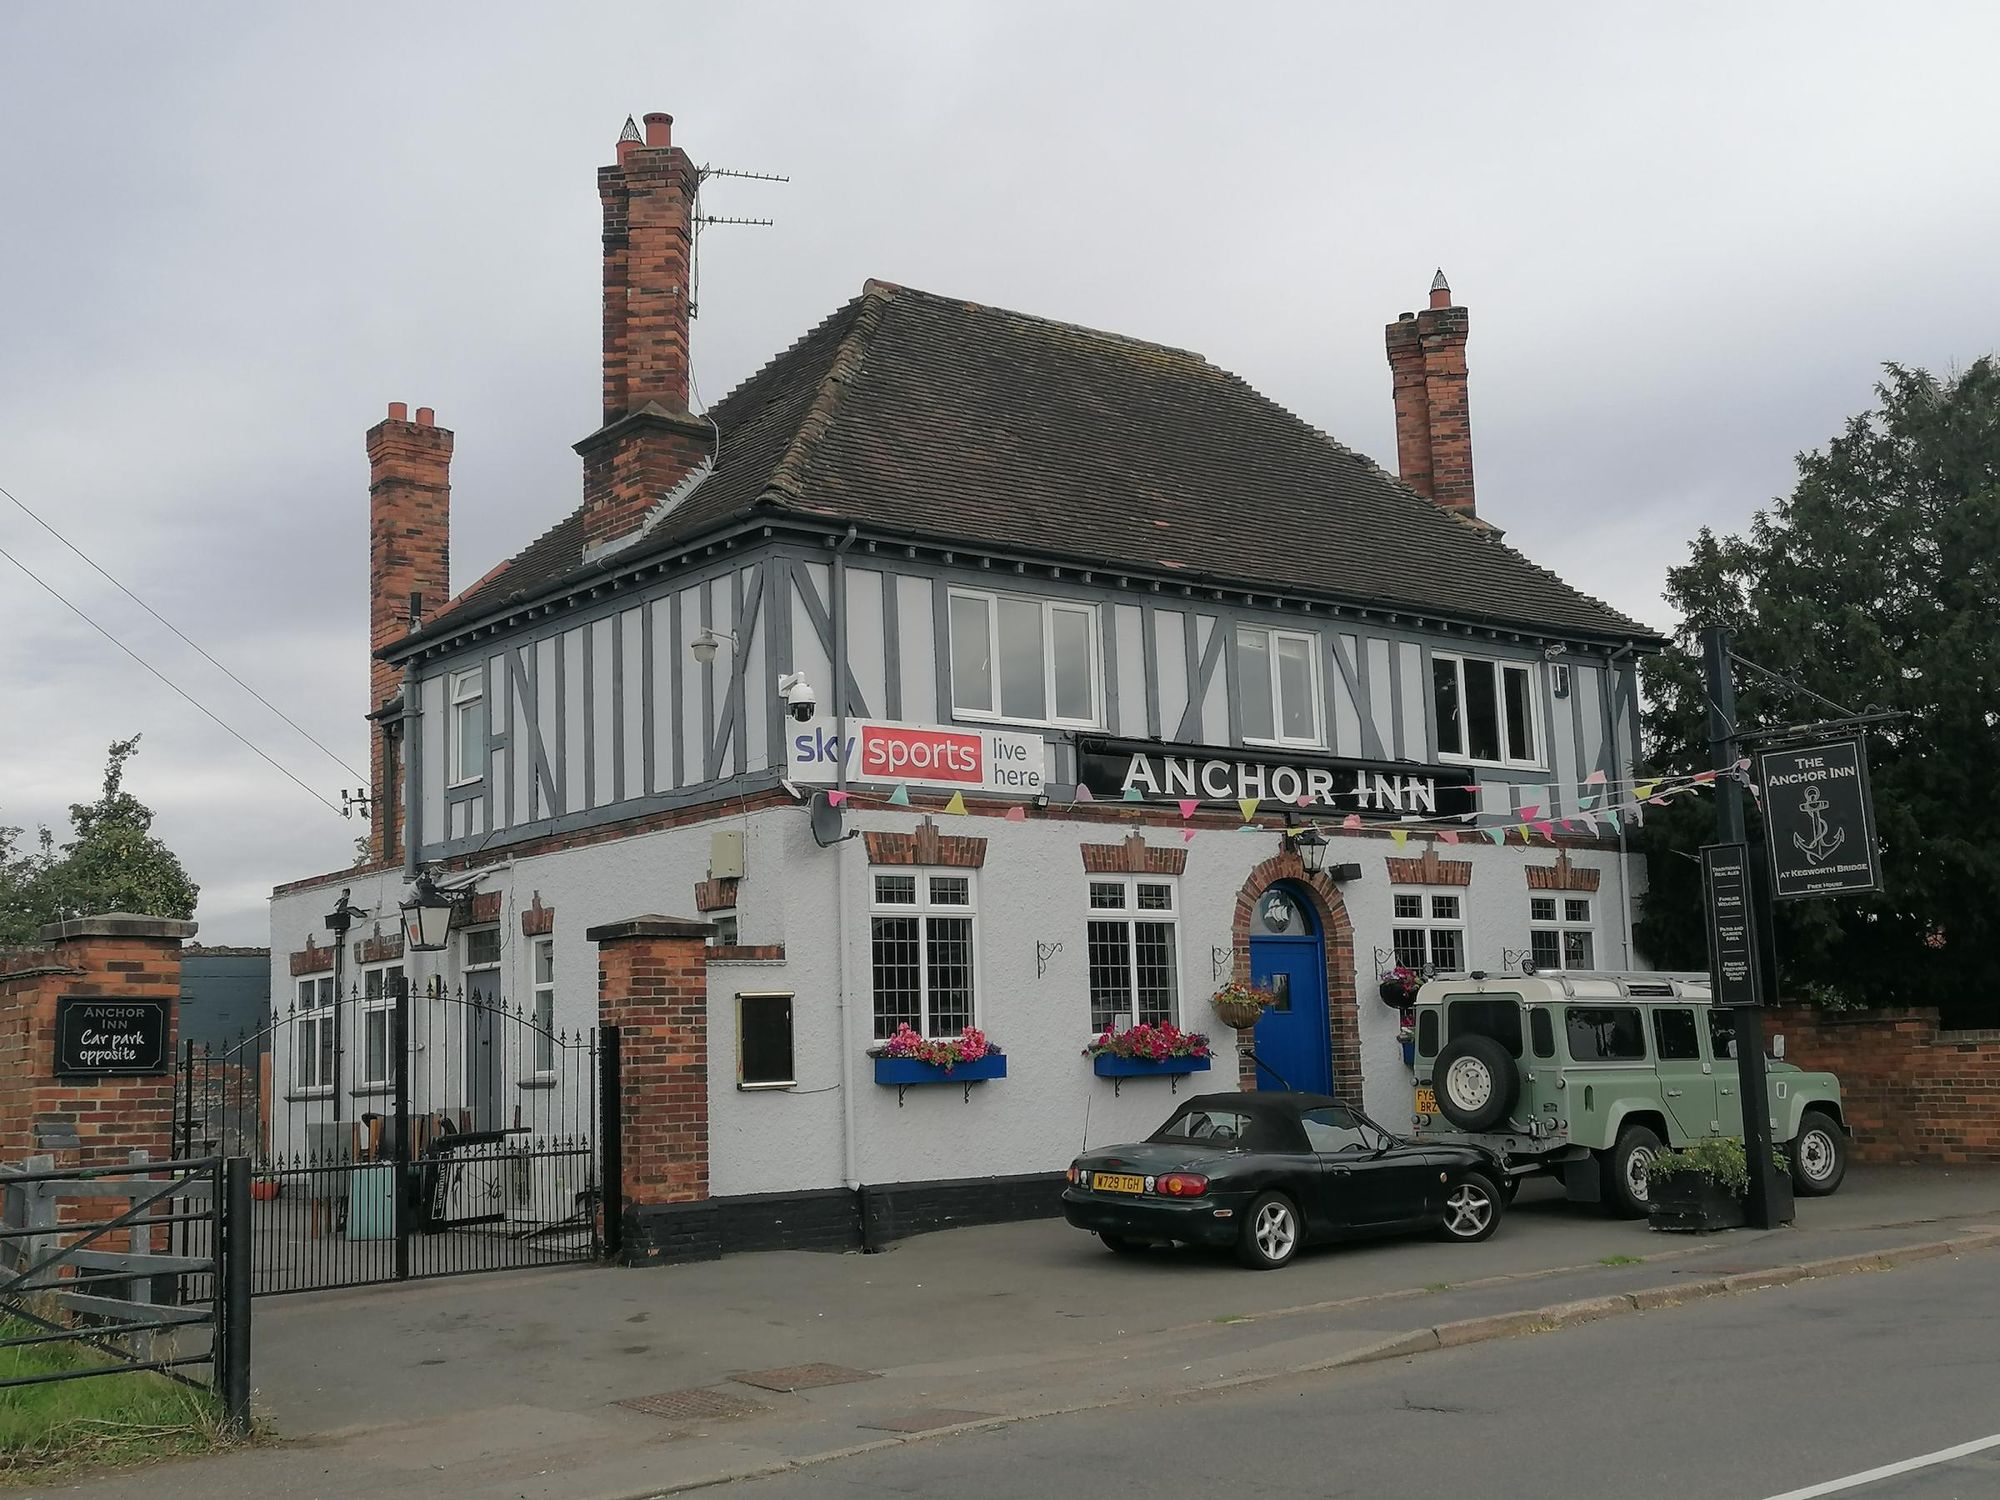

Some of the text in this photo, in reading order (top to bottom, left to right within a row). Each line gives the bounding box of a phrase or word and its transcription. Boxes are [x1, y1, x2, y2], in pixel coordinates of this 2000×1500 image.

[795, 727, 977, 773] sky sports
[993, 737, 1027, 761] live
[1795, 757, 1825, 770] THE
[993, 763, 1040, 787] here
[1121, 752, 1437, 813] ANCHOR INN
[1769, 766, 1856, 787] ANCHOR INN
[1780, 863, 1868, 879] AT KEGWORTH BRIDGE
[83, 1007, 145, 1018] ANCHOR
[102, 1019, 128, 1029] INN
[81, 1029, 145, 1050] Car park
[80, 1047, 137, 1065] opposite
[1122, 1176, 1140, 1190] TGH
